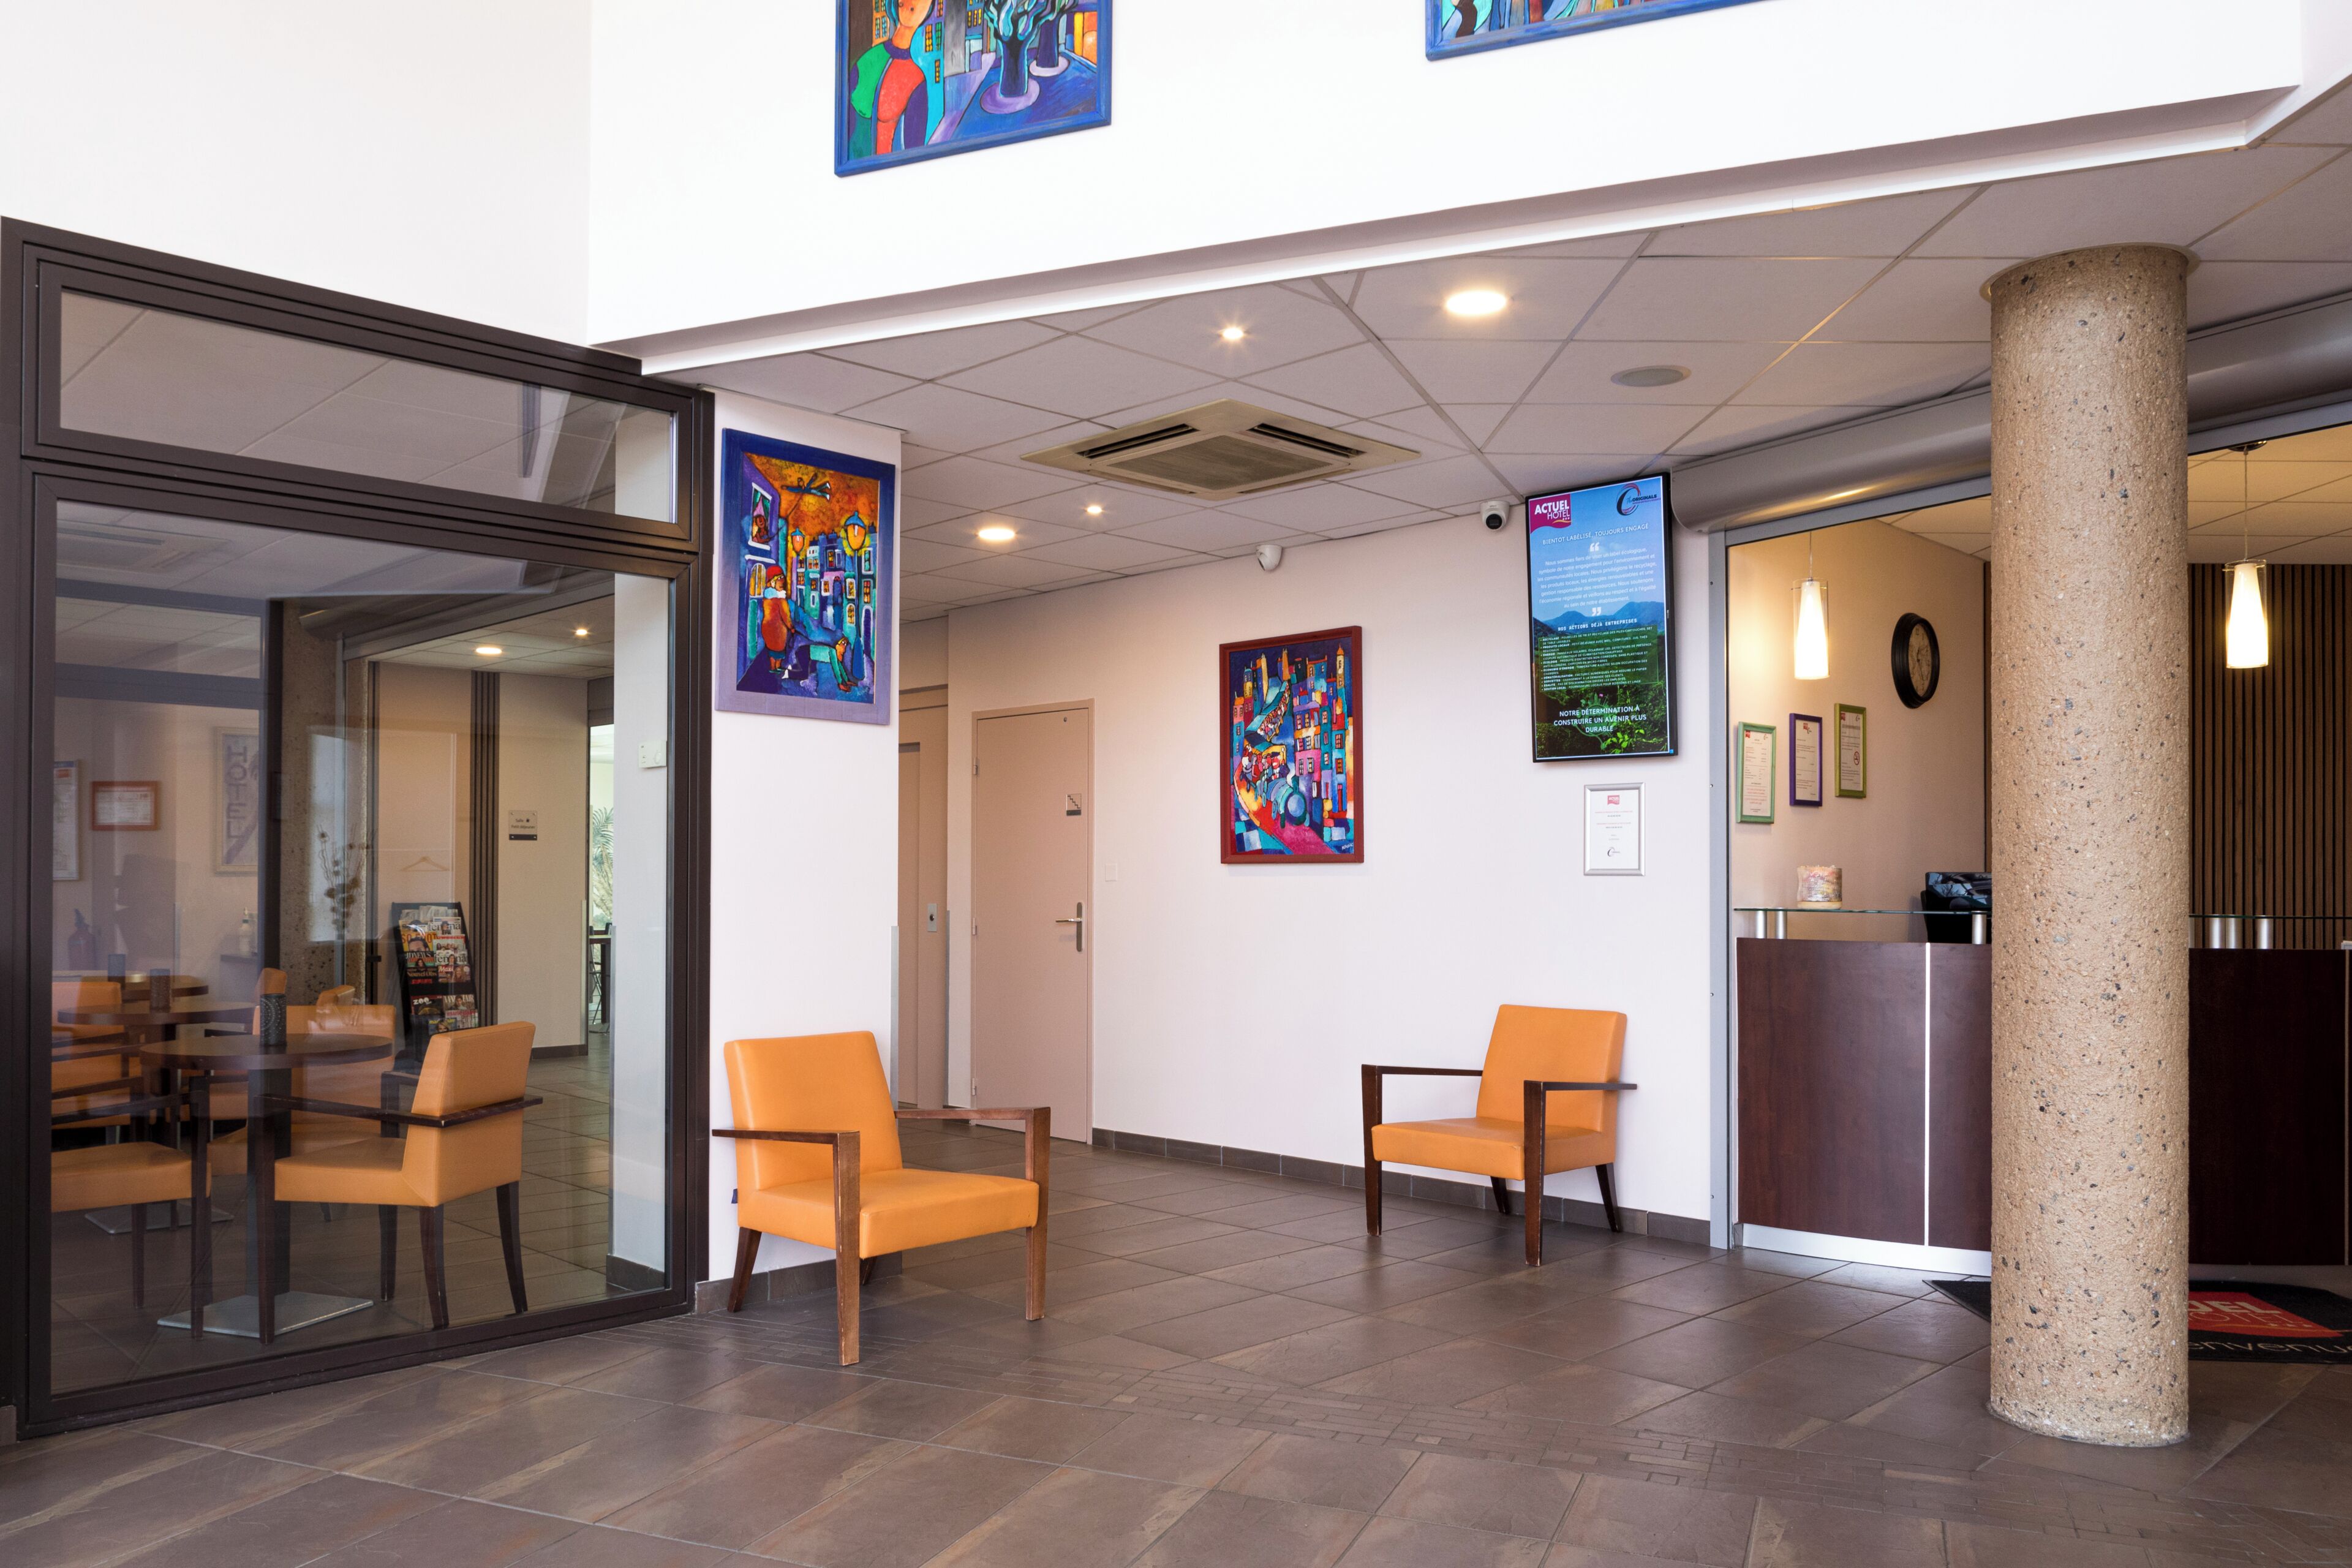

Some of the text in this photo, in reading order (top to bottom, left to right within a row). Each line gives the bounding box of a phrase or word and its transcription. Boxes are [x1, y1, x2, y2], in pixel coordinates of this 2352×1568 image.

[1632, 494, 1656, 502] ORIGINALS
[1534, 499, 1569, 514] ACTUEL
[1542, 536, 1565, 545] BIENTOT
[1595, 527, 1623, 537] TOUJOURS
[1625, 522, 1648, 532] ENGAGÉ
[1581, 705, 1633, 715] DÉTERMINATION
